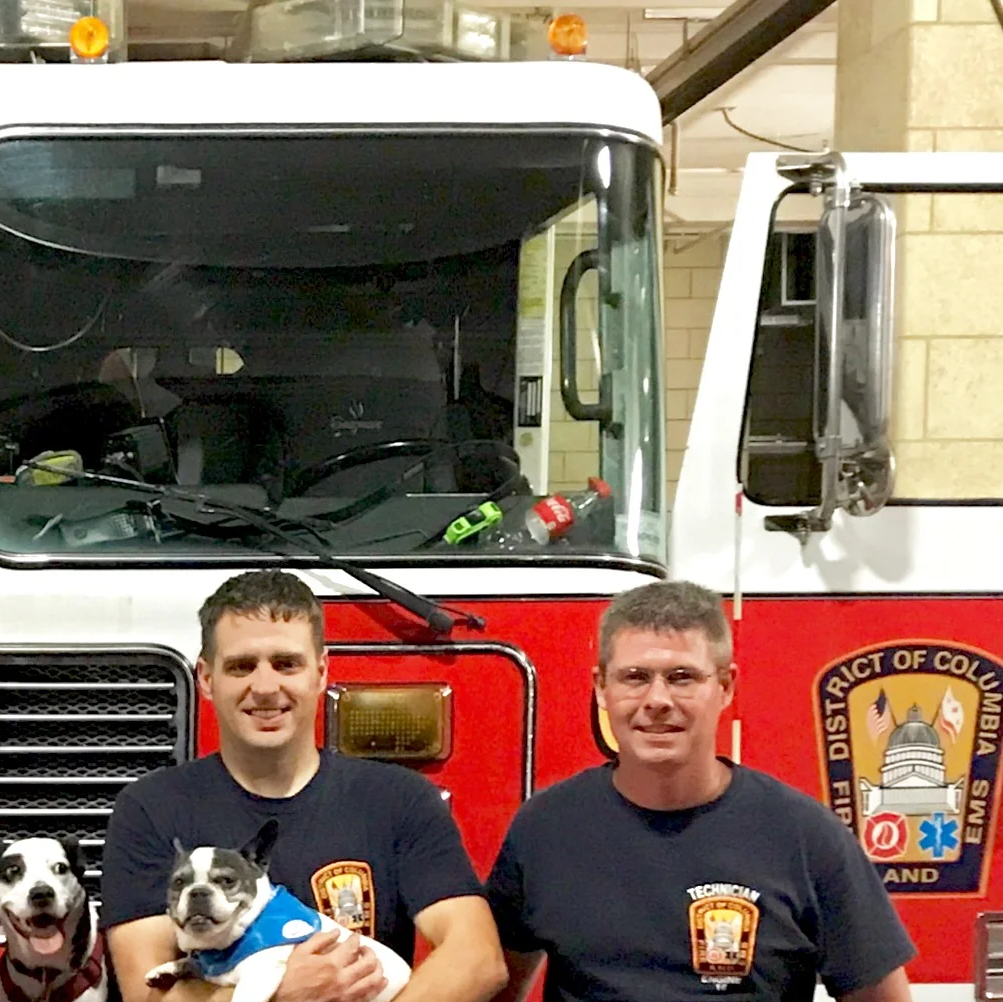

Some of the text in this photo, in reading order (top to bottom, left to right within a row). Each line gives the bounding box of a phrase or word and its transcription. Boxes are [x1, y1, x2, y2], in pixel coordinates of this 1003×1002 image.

[824, 650, 1003, 762] DISTRICT OF COLUMBIA
[832, 781, 854, 833] FIR
[965, 779, 991, 846] EMS
[686, 883, 761, 903] TECHNICIAN
[883, 868, 940, 883] AND
